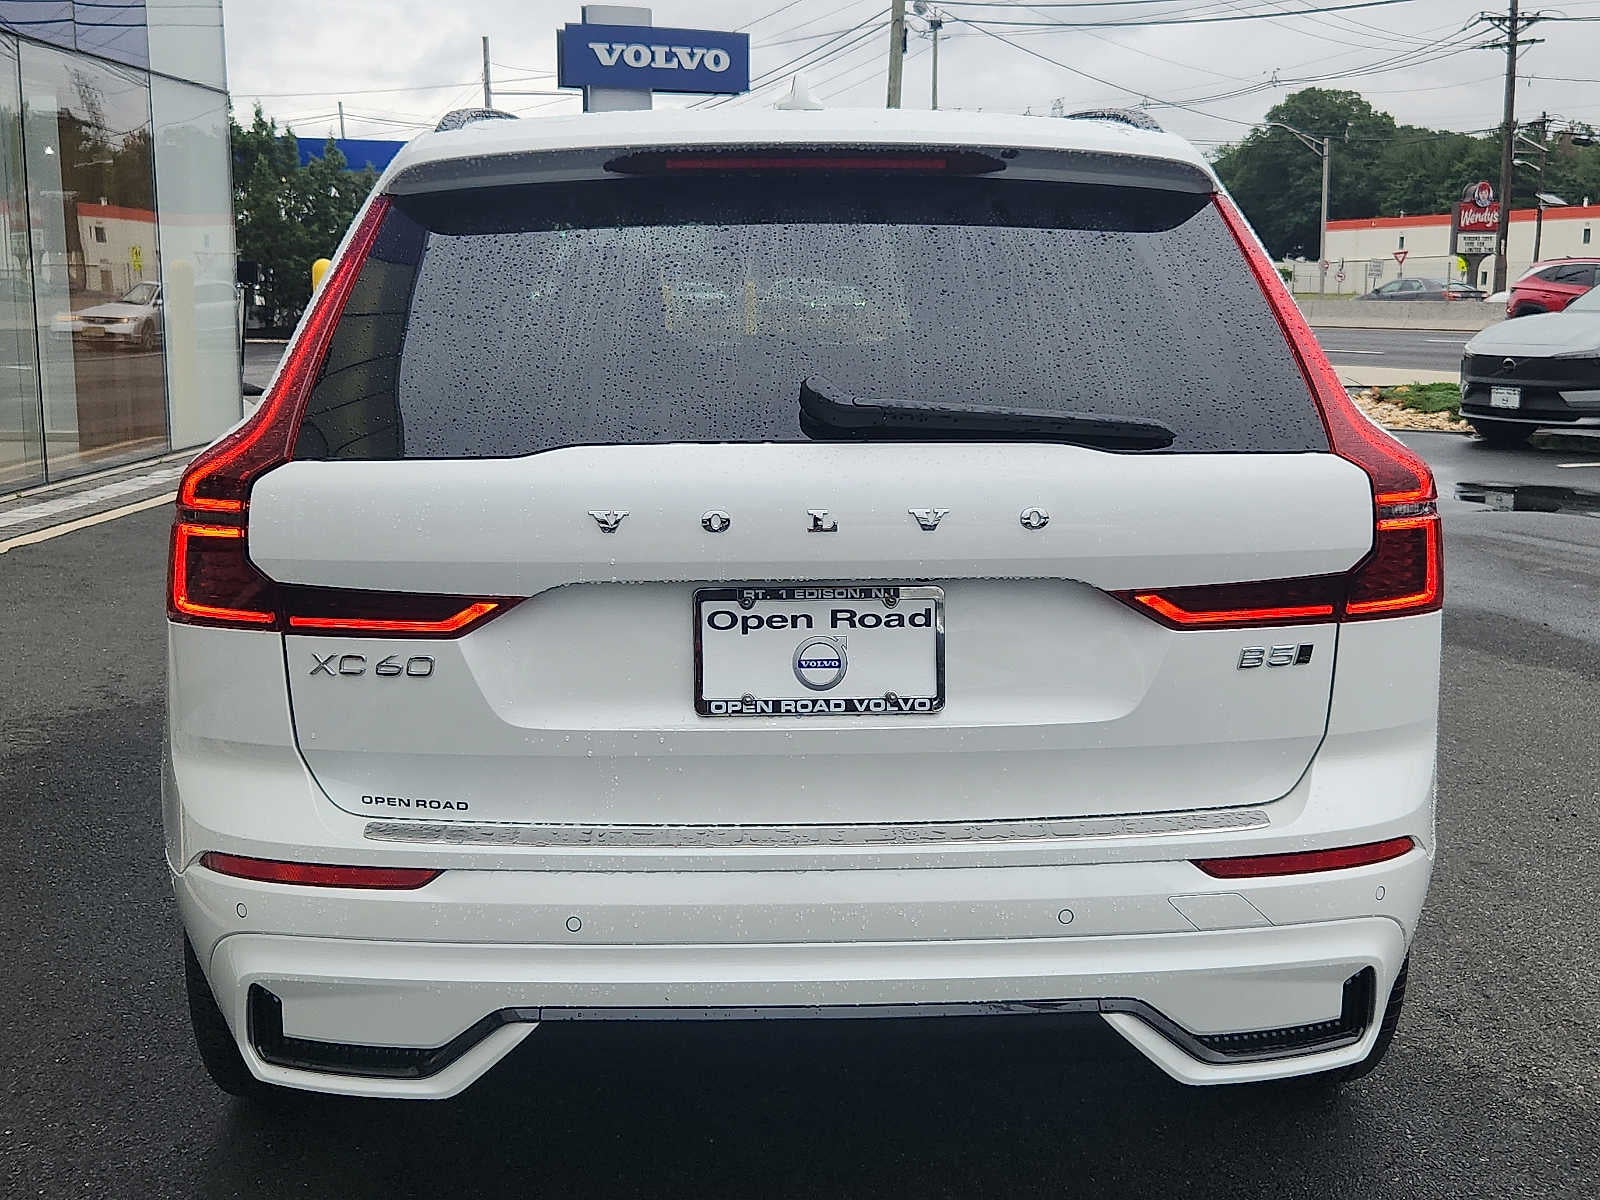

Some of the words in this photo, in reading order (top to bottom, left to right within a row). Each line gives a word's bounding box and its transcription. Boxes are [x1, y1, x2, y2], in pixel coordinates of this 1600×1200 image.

[588, 42, 731, 73] VOLVO
[1460, 207, 1499, 227] Wendy's
[588, 507, 1050, 534] VOLVO
[743, 589, 770, 600] RT.
[779, 590, 787, 599] 1
[794, 589, 865, 599] EDISON,
[707, 610, 813, 634] Open
[831, 608, 931, 629] Road
[710, 701, 773, 714] OPEN
[781, 701, 845, 712] ROAD
[853, 699, 931, 712] VOLVO
[361, 795, 411, 808] OPEN
[415, 799, 469, 811] ROAD
